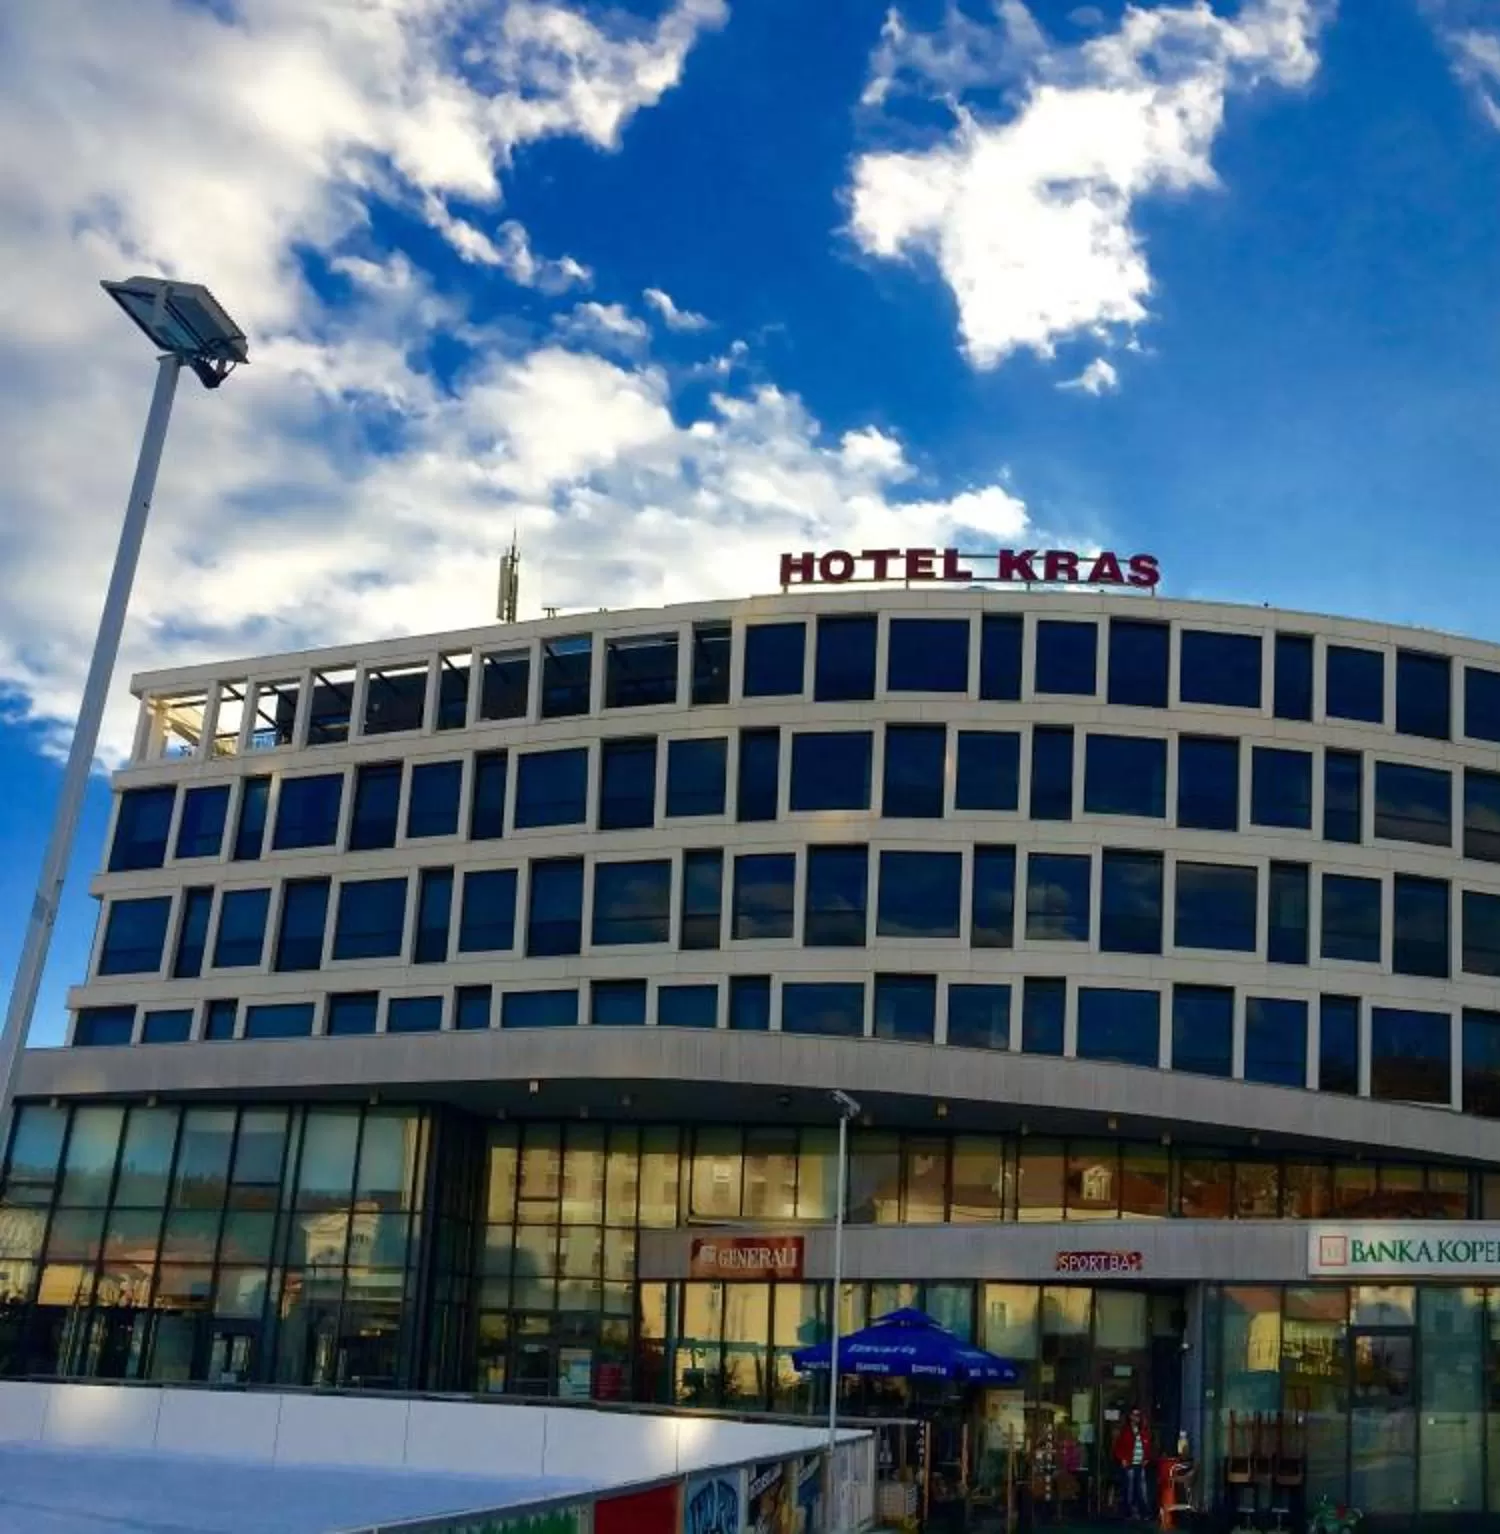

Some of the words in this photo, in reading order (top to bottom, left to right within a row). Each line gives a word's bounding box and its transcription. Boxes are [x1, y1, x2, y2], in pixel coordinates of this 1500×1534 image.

[780, 549, 973, 583] HOTEL
[998, 549, 1160, 587] KRAS
[718, 1246, 799, 1269] GENERALI
[1350, 1240, 1435, 1263] BANKA
[1059, 1255, 1108, 1272] SPORT
